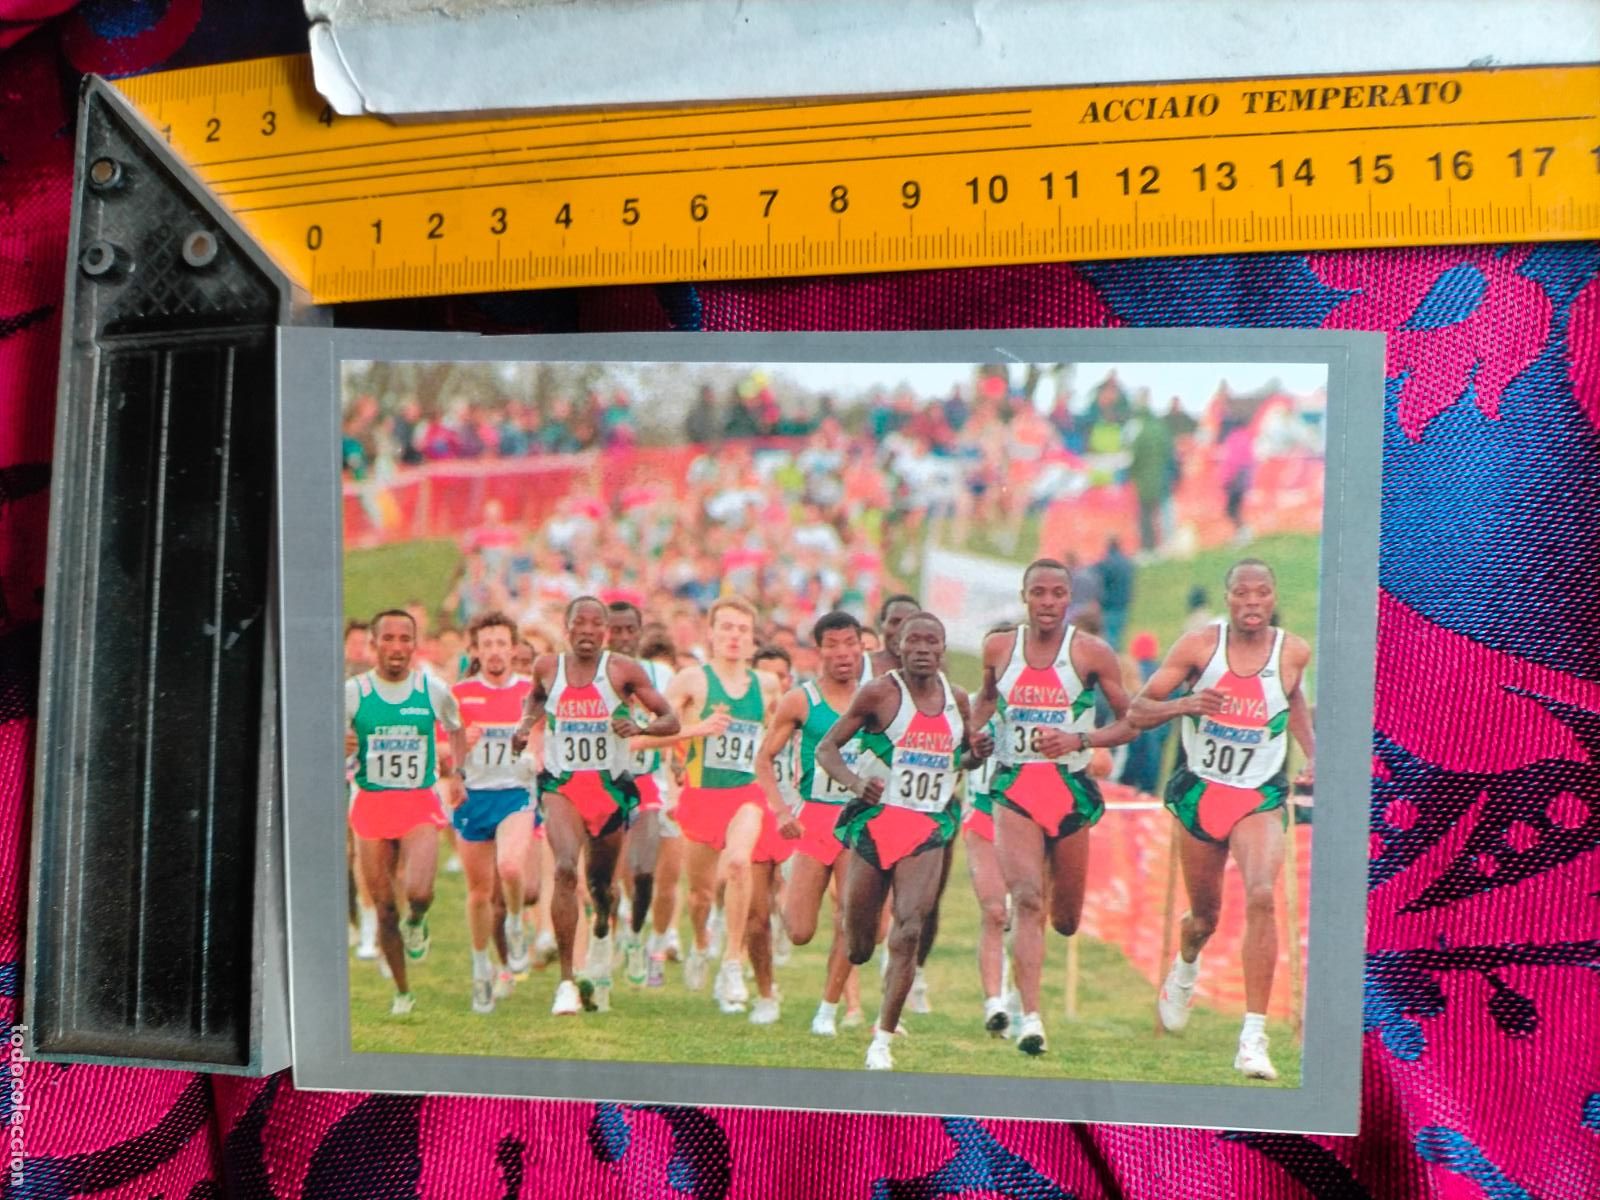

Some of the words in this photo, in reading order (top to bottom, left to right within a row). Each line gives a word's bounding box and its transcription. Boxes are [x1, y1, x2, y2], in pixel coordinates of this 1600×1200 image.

[1079, 93, 1219, 124] ACCIAIO
[1242, 80, 1463, 115] TEMPERATO
[205, 118, 221, 142] 2
[261, 110, 277, 136] 3
[318, 103, 334, 128] 4
[306, 225, 322, 250] 0
[371, 219, 382, 244] 1
[427, 213, 444, 239] 2
[490, 207, 507, 234] 3
[554, 203, 573, 229] 4
[622, 199, 640, 225] 5
[690, 195, 708, 222] 6
[759, 190, 778, 218] 7
[830, 185, 849, 213] 8
[902, 181, 921, 209] 9
[965, 175, 1008, 205] 10
[1040, 171, 1079, 200] 11
[1116, 165, 1160, 196] 12
[1193, 161, 1238, 192] 13
[1270, 158, 1315, 188] 14
[1349, 154, 1395, 185] 15
[1427, 150, 1474, 182] 16
[1508, 146, 1555, 177] 17
[1013, 686, 1065, 705] KENYA
[1219, 695, 1264, 719] ENYA
[558, 700, 608, 718] KENYA
[1010, 708, 1066, 724] SNICKERS
[904, 731, 953, 753] KENYA
[1204, 720, 1264, 745] SNICKERS
[564, 736, 607, 762] 308
[716, 734, 754, 764] 394
[1202, 738, 1255, 776] 307
[377, 754, 418, 780] 155
[900, 769, 944, 801] 305
